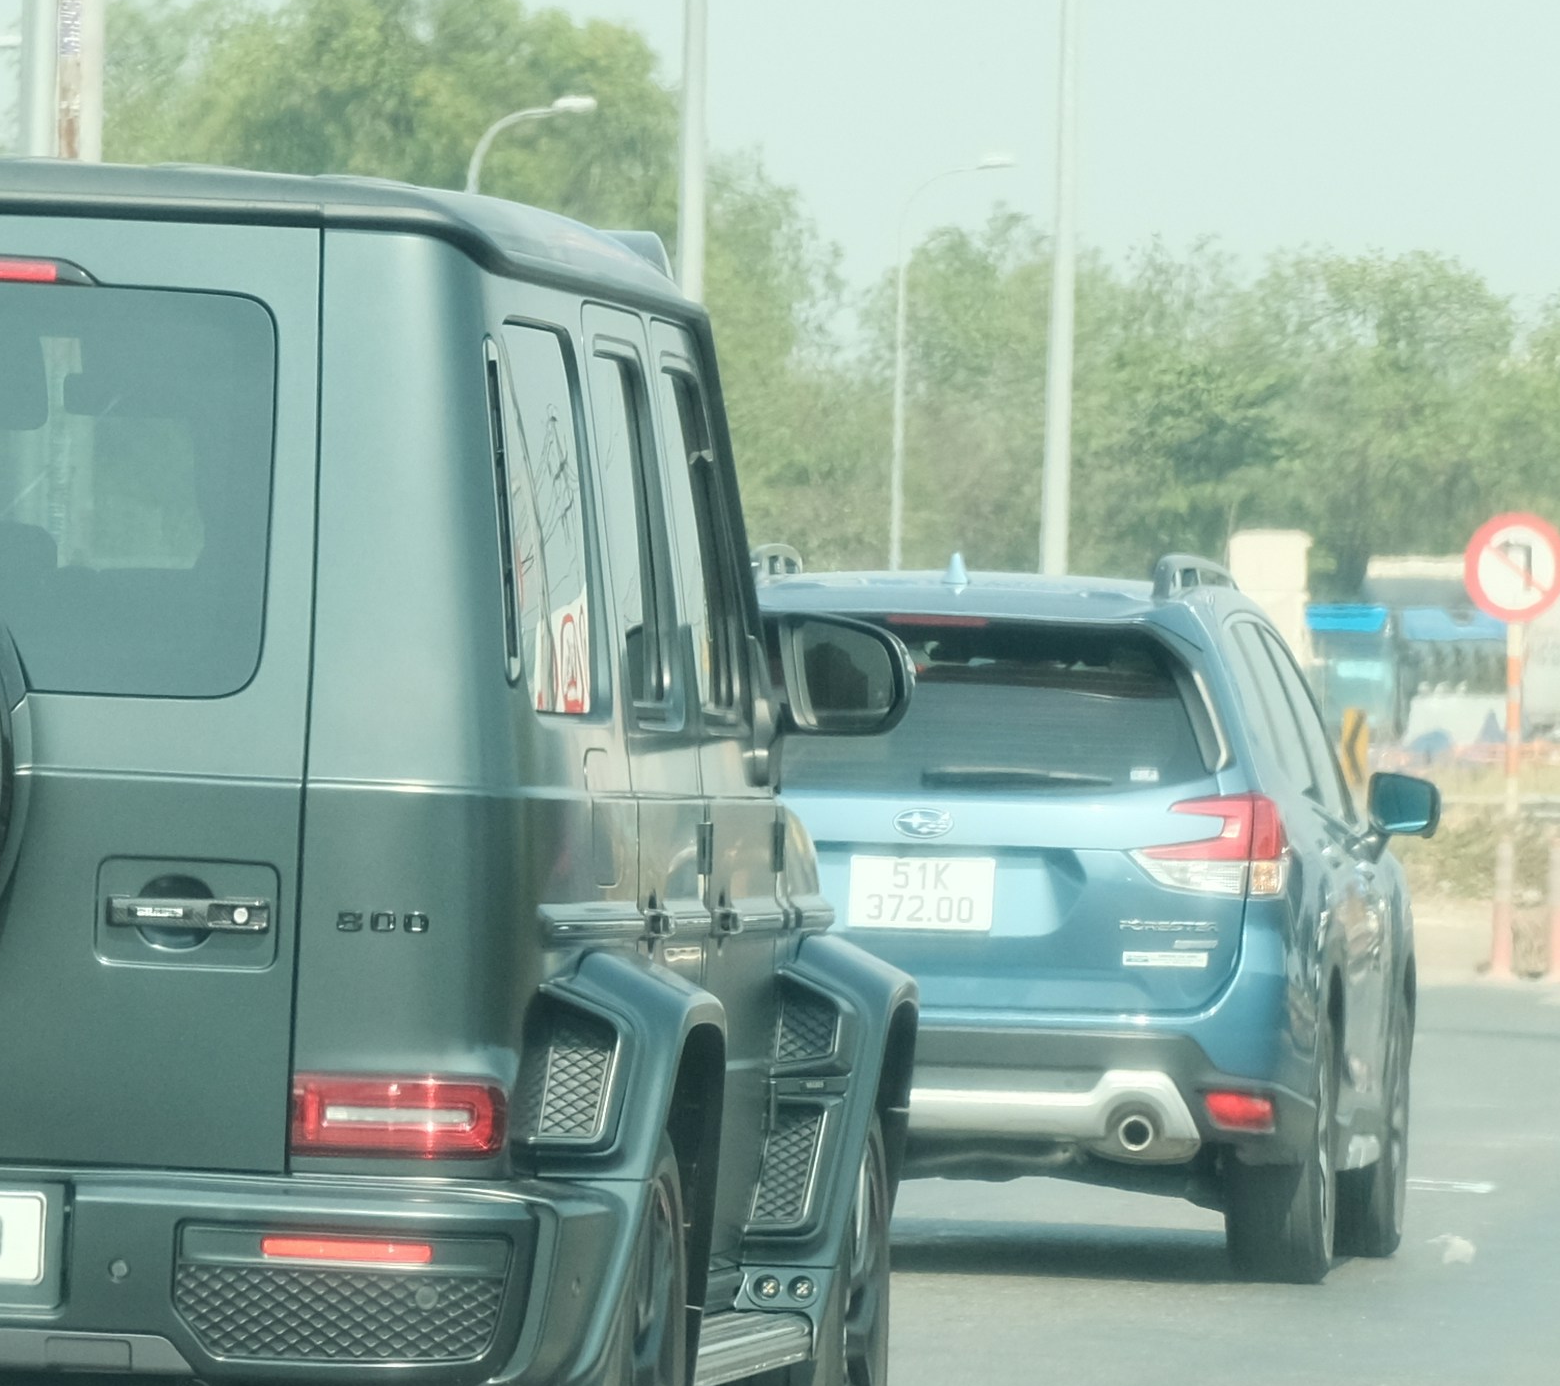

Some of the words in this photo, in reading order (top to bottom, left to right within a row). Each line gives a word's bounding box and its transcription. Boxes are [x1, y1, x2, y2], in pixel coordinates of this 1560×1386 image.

[892, 861, 951, 891] 51K
[336, 910, 429, 934] 800
[865, 893, 974, 923] 372.00
